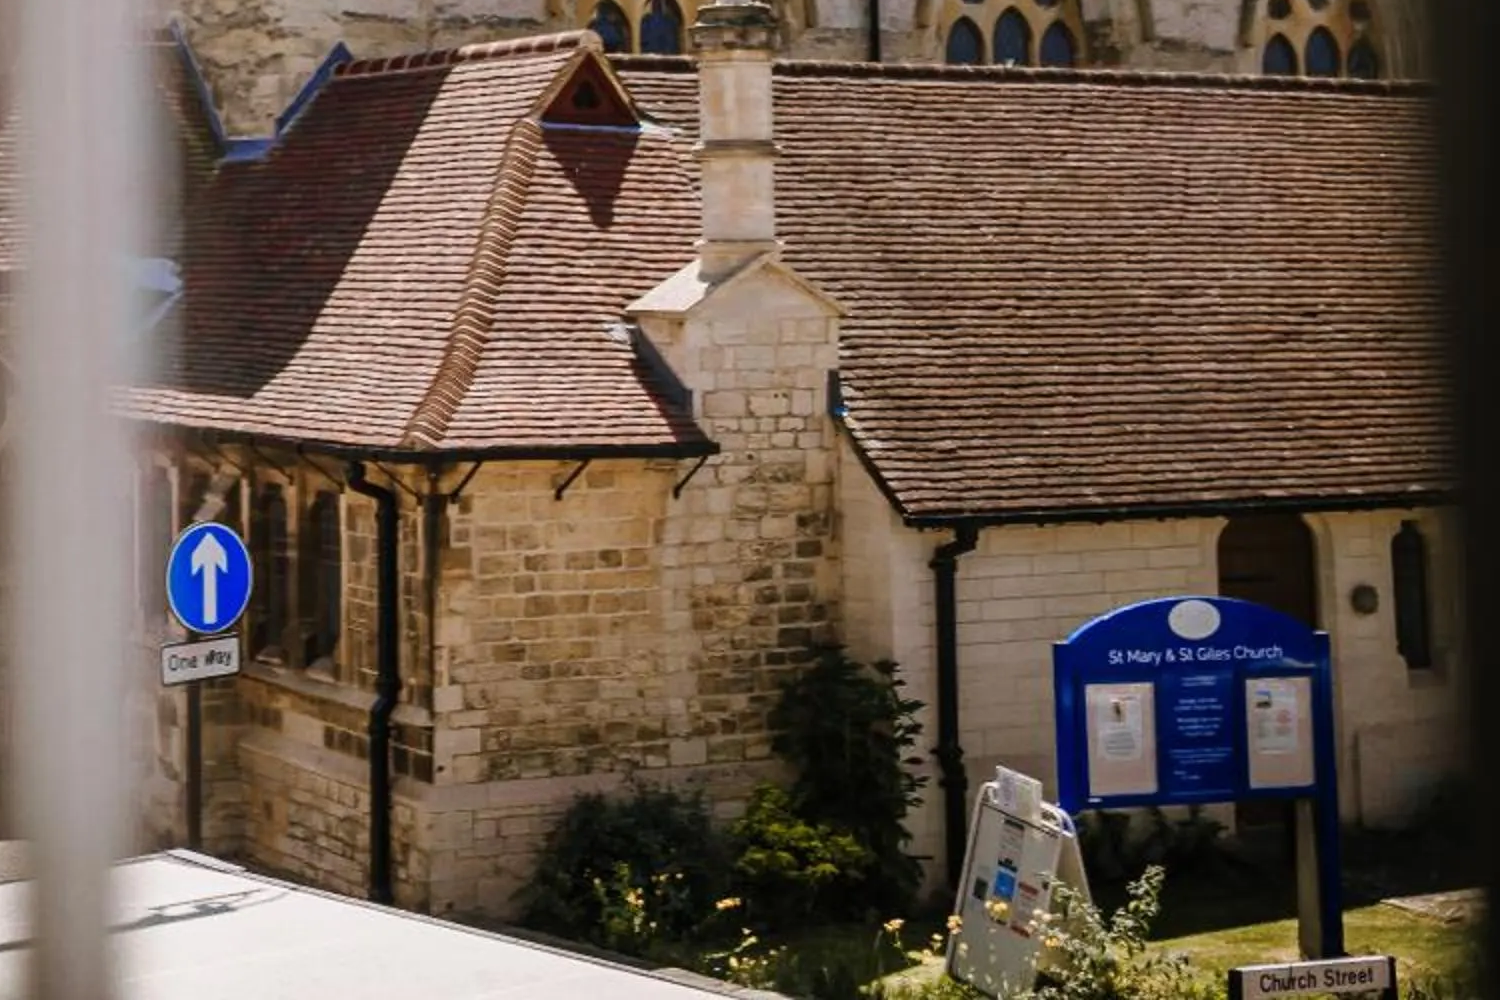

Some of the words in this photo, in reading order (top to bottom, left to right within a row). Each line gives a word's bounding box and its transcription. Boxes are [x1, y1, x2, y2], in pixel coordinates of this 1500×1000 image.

[168, 653, 197, 672] One
[1108, 648, 1124, 665] St
[1127, 648, 1162, 667] Mary
[1165, 648, 1176, 663] &
[1179, 647, 1195, 662] St
[1196, 645, 1231, 661] Giles
[1233, 643, 1283, 660] Church
[1259, 970, 1317, 993] Church
[1323, 966, 1373, 987] Street
